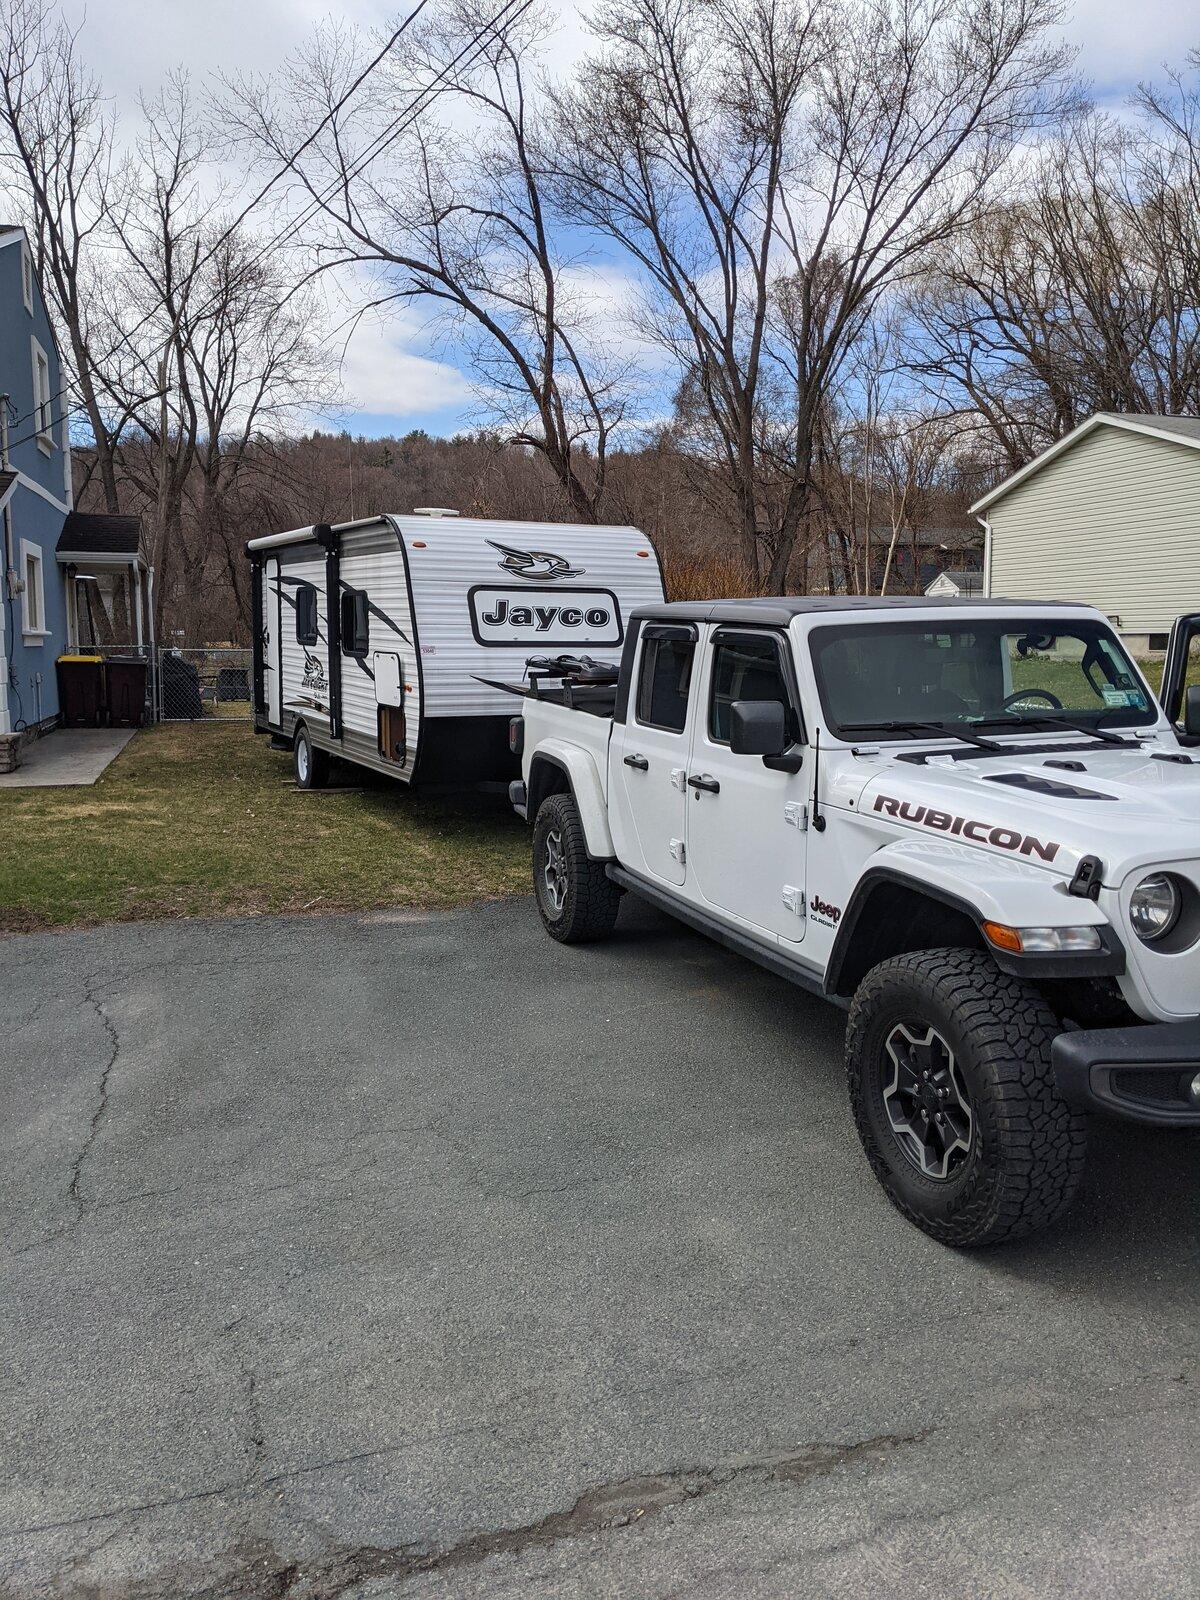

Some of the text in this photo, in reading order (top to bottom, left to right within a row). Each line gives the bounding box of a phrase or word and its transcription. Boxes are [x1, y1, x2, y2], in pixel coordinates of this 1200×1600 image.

[482, 599, 610, 631] Jayco
[873, 794, 1061, 863] RUBICON
[810, 894, 842, 923] Jeep
[810, 914, 838, 930] GLADIAT
